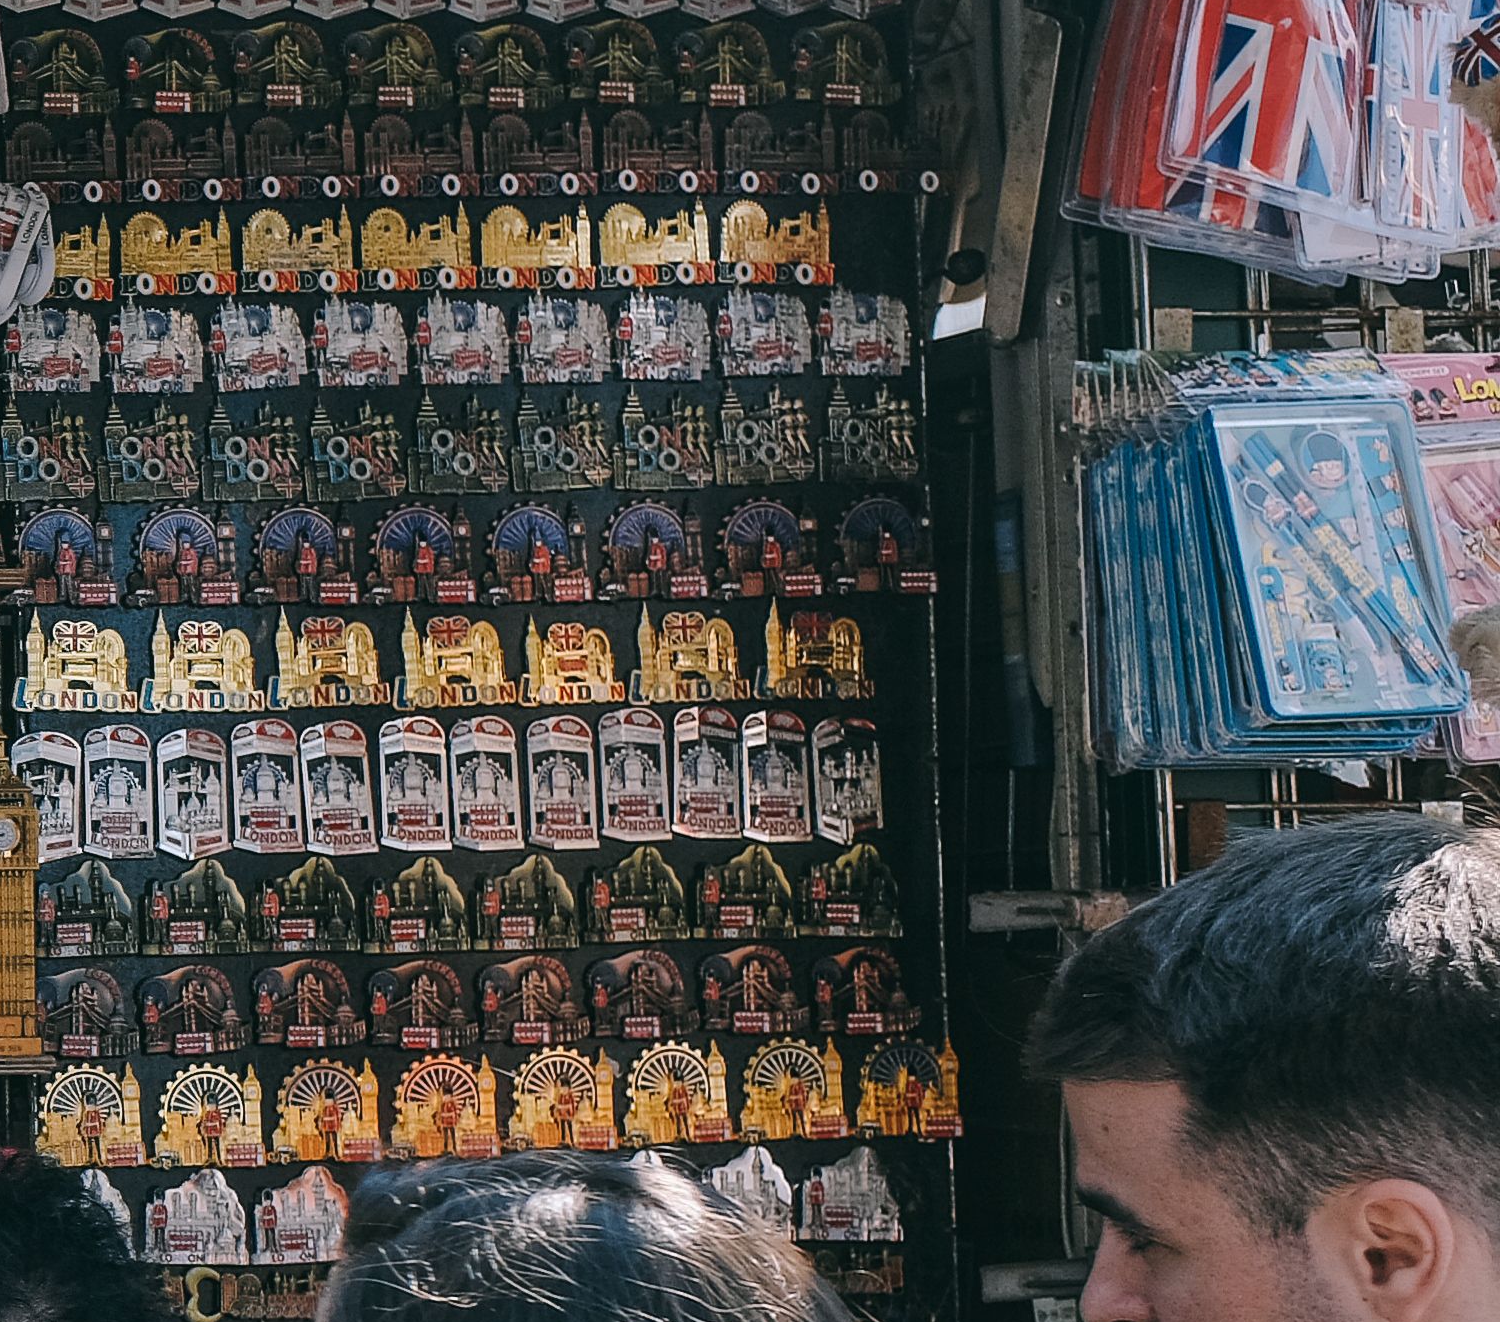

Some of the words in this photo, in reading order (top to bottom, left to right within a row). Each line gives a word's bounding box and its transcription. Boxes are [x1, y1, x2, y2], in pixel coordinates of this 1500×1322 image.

[21, 211, 40, 244] LONDON
[120, 271, 237, 296] LONDON
[600, 260, 716, 287] LONDON
[13, 675, 138, 712] LONDON
[268, 674, 390, 711] LONDON
[629, 671, 751, 707] LONDON
[209, 825, 262, 839] LONDON
